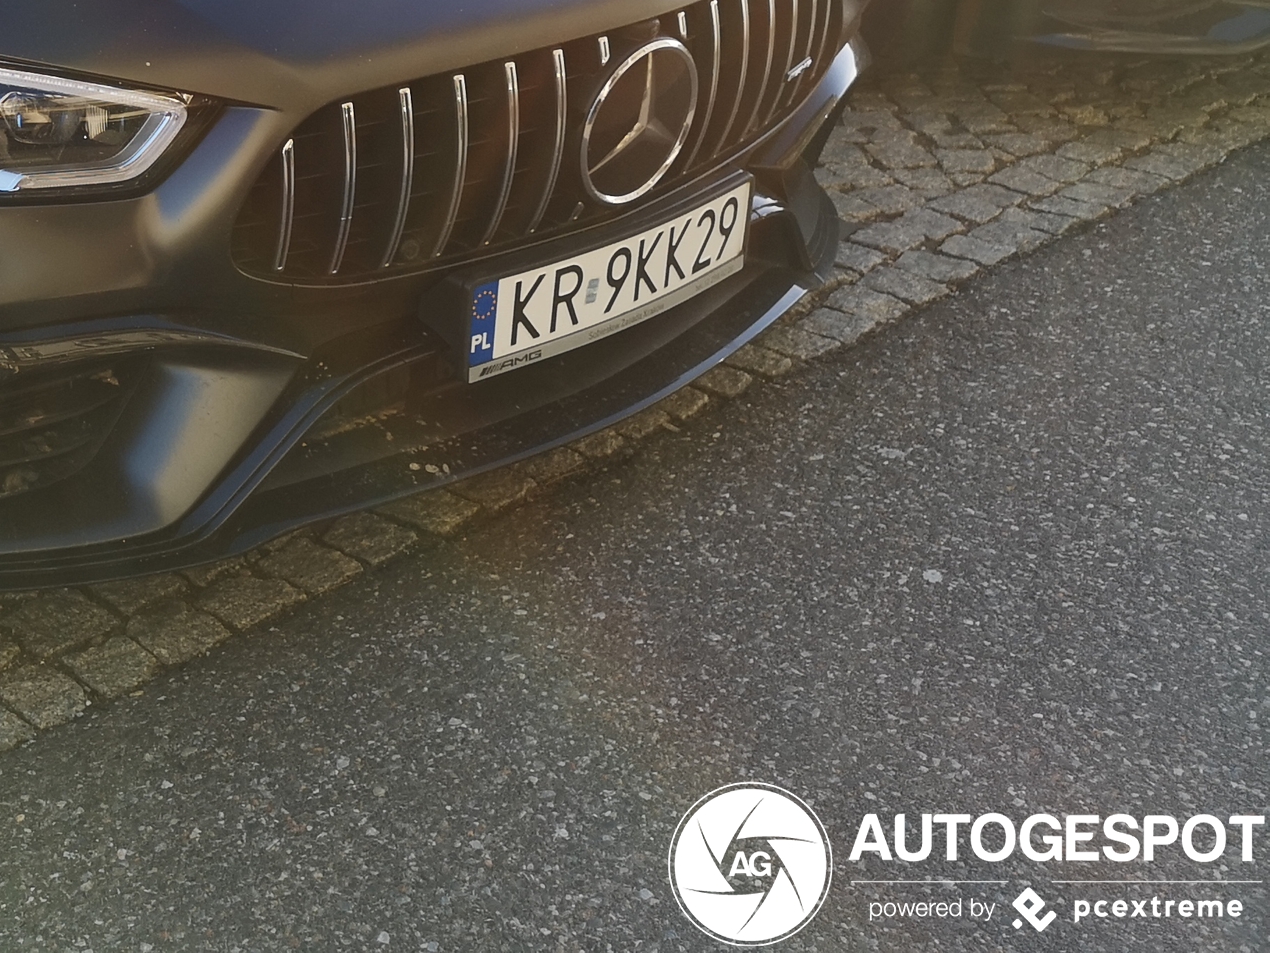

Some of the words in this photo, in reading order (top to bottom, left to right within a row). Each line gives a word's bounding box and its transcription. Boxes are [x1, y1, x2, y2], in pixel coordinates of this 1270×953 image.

[510, 265, 583, 346] KR
[604, 197, 738, 314] 9KK29
[470, 332, 491, 353] PL
[500, 350, 542, 370] AMG
